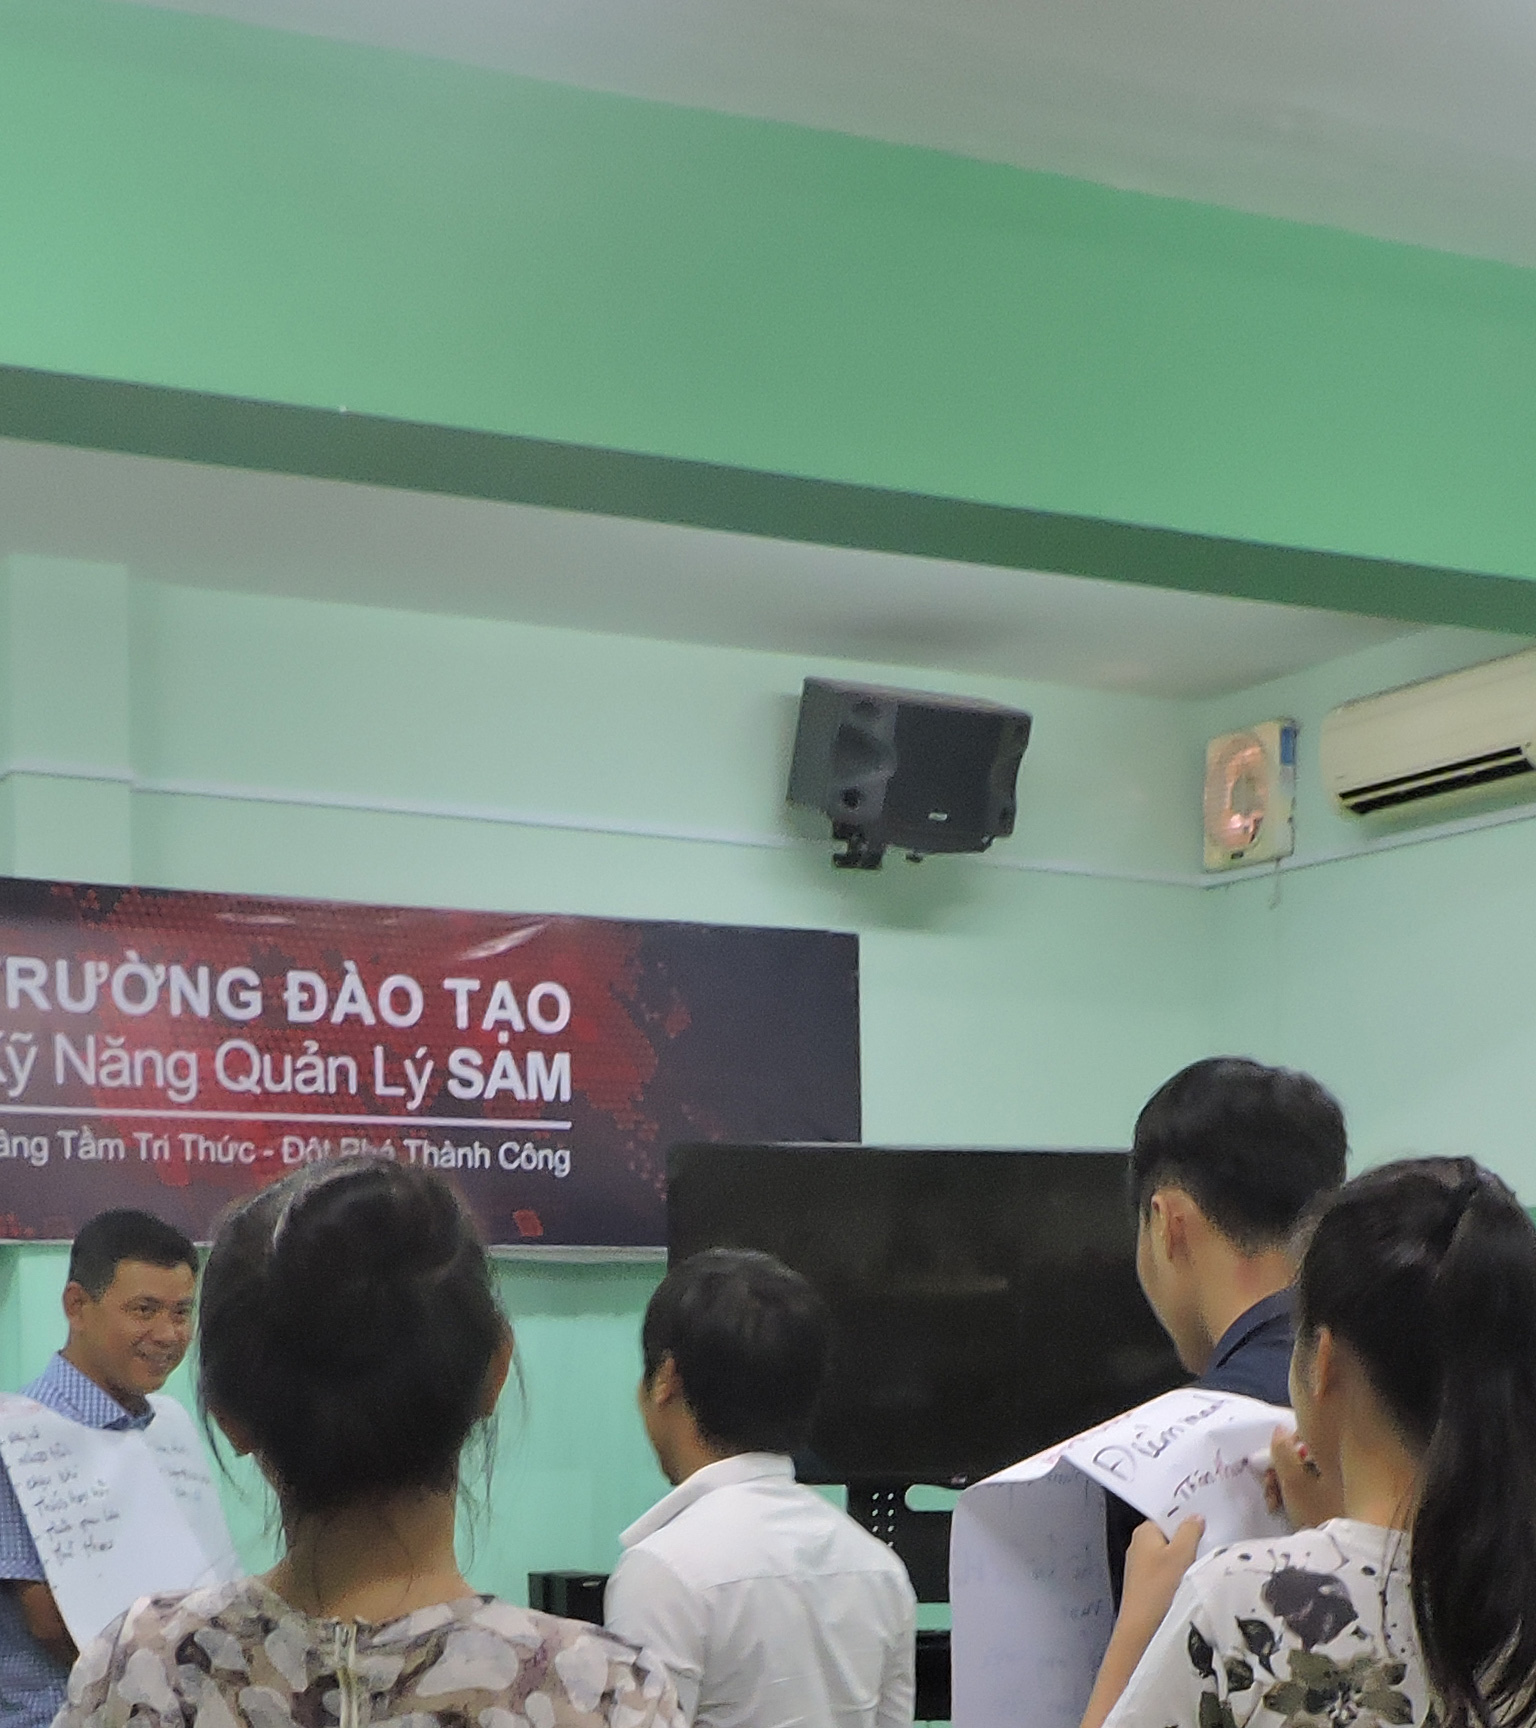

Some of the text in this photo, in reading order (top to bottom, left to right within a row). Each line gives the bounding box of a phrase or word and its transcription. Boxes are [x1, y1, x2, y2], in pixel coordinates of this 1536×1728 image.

[283, 961, 424, 1029] ĐÀO
[444, 977, 572, 1043] TẠO
[54, 1034, 199, 1103] Năng
[215, 1039, 358, 1096] Quản
[373, 1047, 434, 1110] Lý
[447, 1047, 572, 1103] SAM
[178, 1133, 257, 1166] Thức
[402, 1137, 491, 1171] Thành
[497, 1140, 572, 1179] Công
